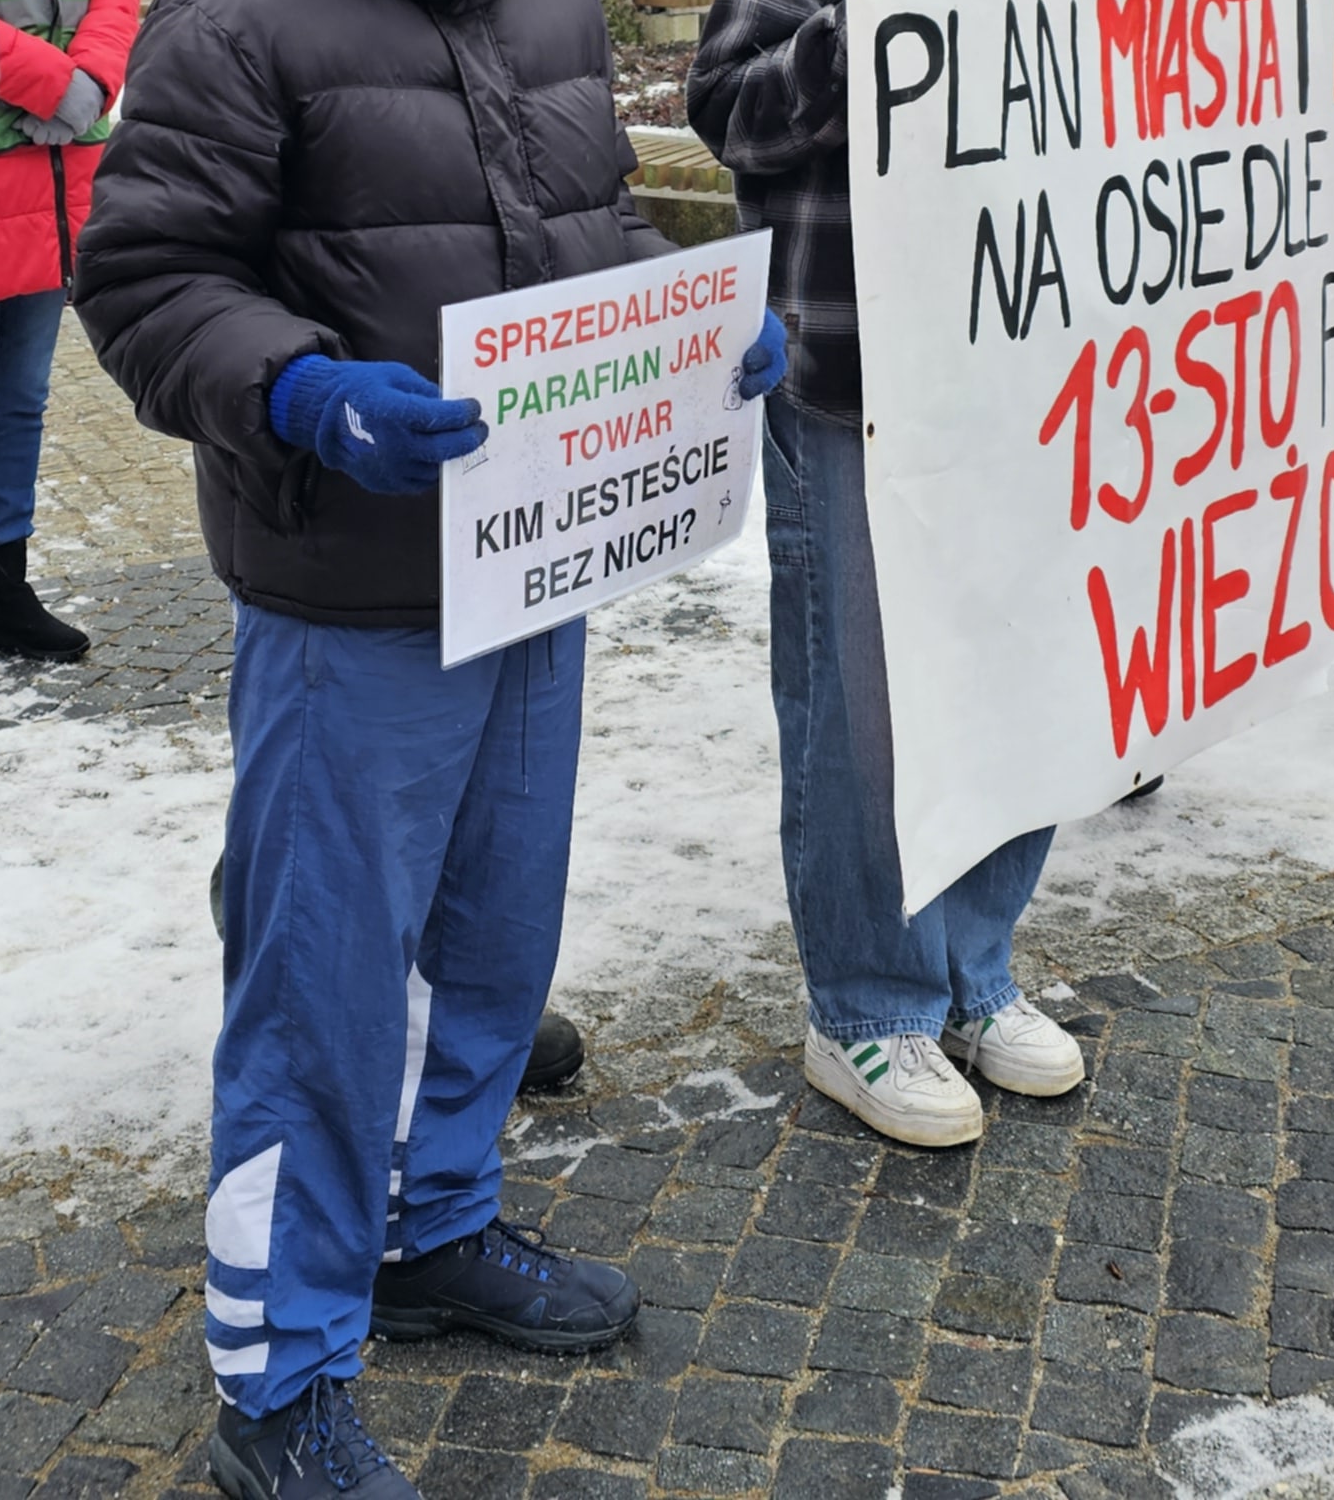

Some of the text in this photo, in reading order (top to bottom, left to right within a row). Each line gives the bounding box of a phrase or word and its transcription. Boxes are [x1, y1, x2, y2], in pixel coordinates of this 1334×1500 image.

[969, 189, 1071, 345] NA
[1096, 130, 1328, 305] OSIEDLE
[474, 265, 738, 368] SPRZEDALIŚCIE
[497, 326, 722, 425] PARAFIAN JAK
[1038, 279, 1301, 532] 13-STO
[559, 400, 673, 467] TOWAR
[475, 436, 729, 559] KIM JESTEŚCIE
[524, 507, 697, 609] BEZ NICH?
